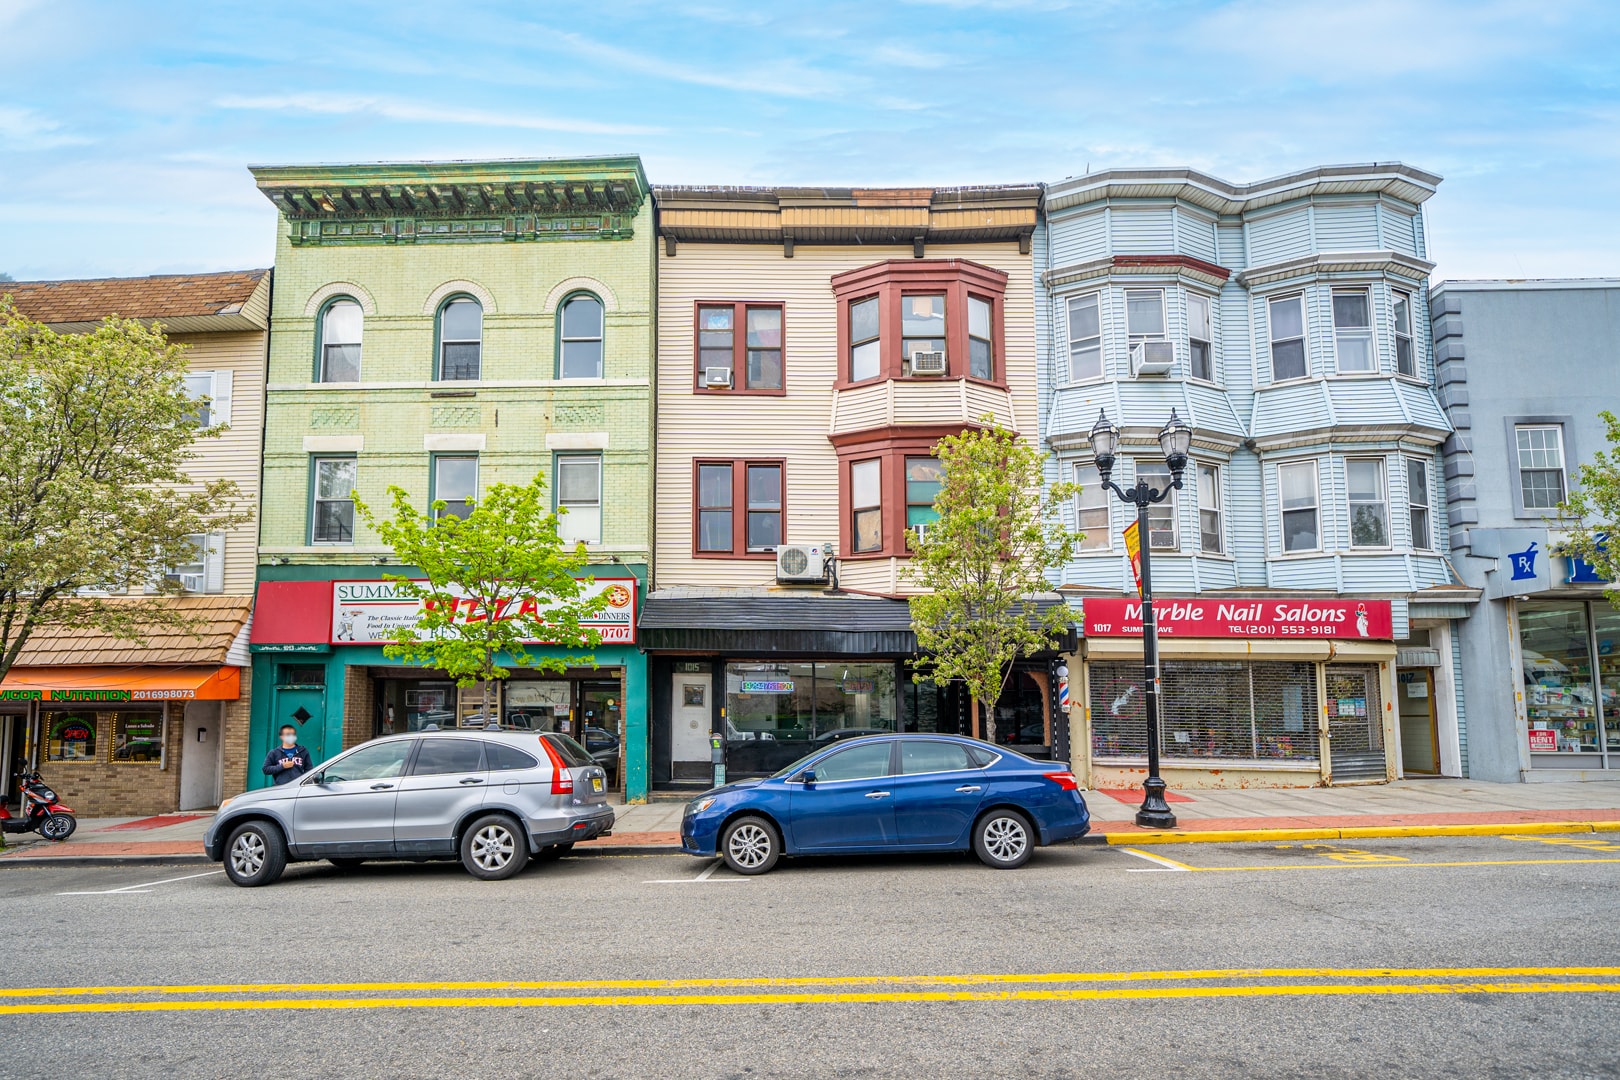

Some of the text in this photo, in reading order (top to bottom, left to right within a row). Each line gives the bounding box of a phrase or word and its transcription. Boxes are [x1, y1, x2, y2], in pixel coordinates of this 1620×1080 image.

[338, 585, 423, 598] SUMMI
[598, 612, 630, 620] DINNERS
[1216, 603, 1263, 621] Nail
[1272, 603, 1347, 622] Salons
[1093, 623, 1112, 633] 1017
[1281, 625, 1336, 634] 553-9181
[368, 632, 383, 640] WE
[685, 662, 700, 672] 1015
[1397, 672, 1415, 684] 1017
[0, 690, 195, 701] VIGOR NUTRITION 2016998073
[1530, 736, 1554, 744] RENT
